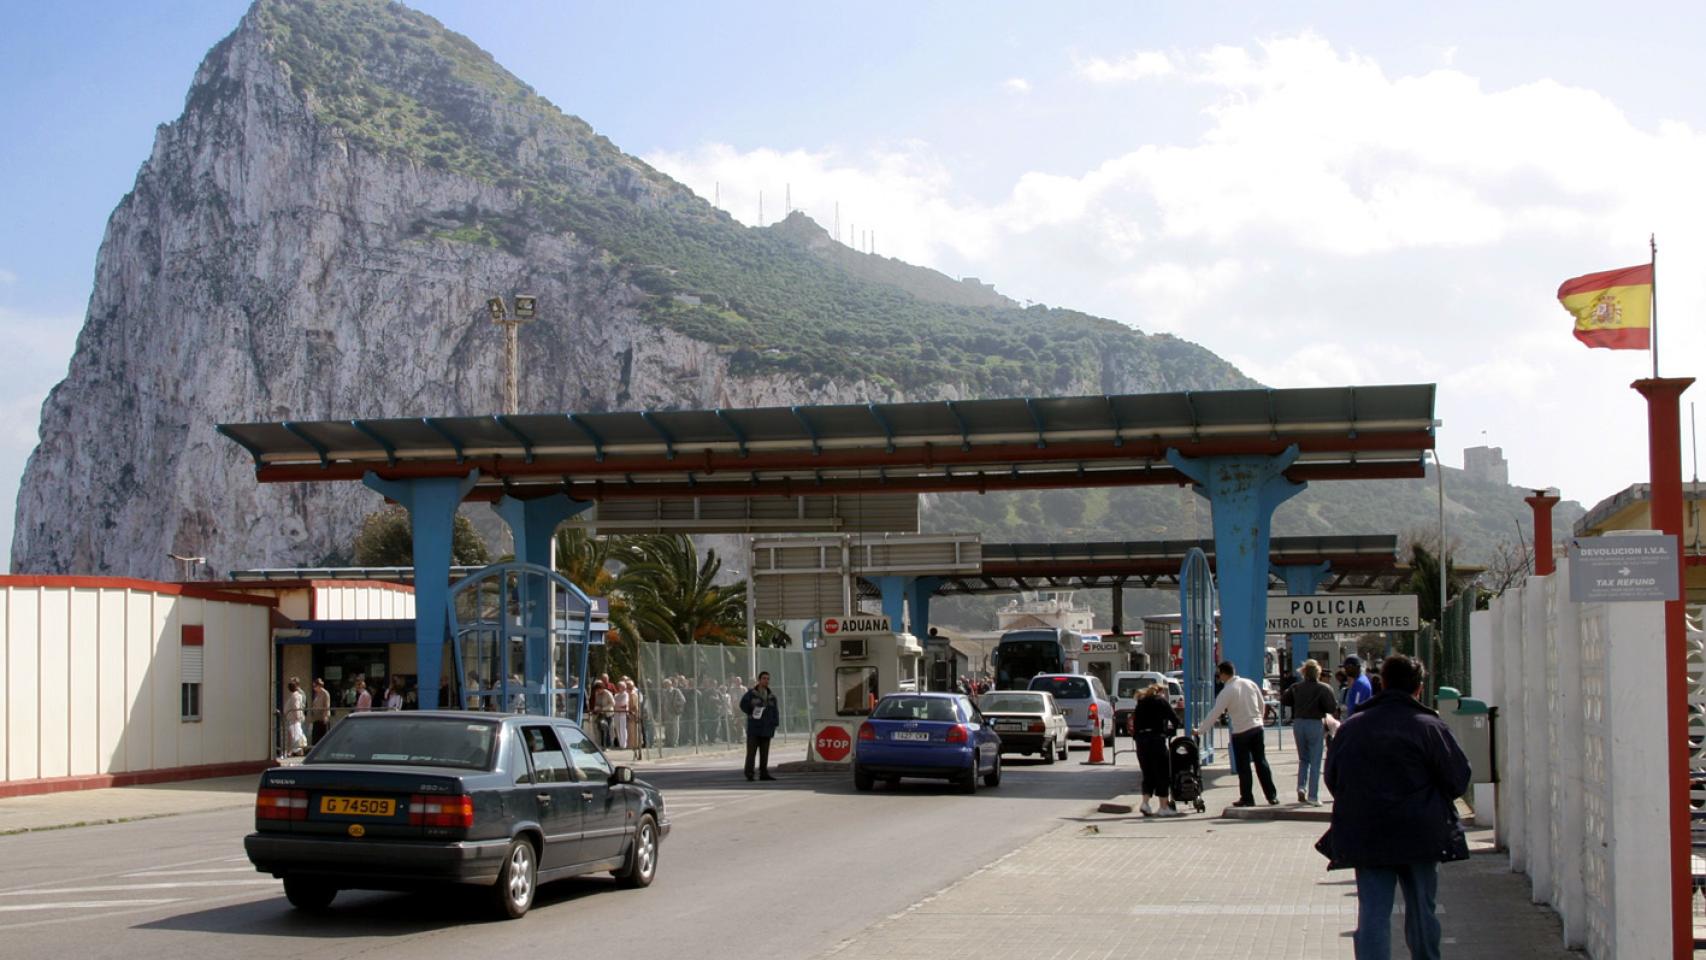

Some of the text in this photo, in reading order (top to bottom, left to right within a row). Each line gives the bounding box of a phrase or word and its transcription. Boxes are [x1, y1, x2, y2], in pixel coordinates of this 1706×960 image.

[1580, 546, 1667, 556] DEVOLUCION I.V.A.
[1616, 578, 1656, 586] REFUND
[1291, 600, 1366, 615] POLICIA
[841, 619, 889, 632] ADUANA
[1266, 616, 1410, 629] NTROL DE PASAPORTES
[819, 738, 849, 749] STOP
[326, 799, 389, 813] G 74509
